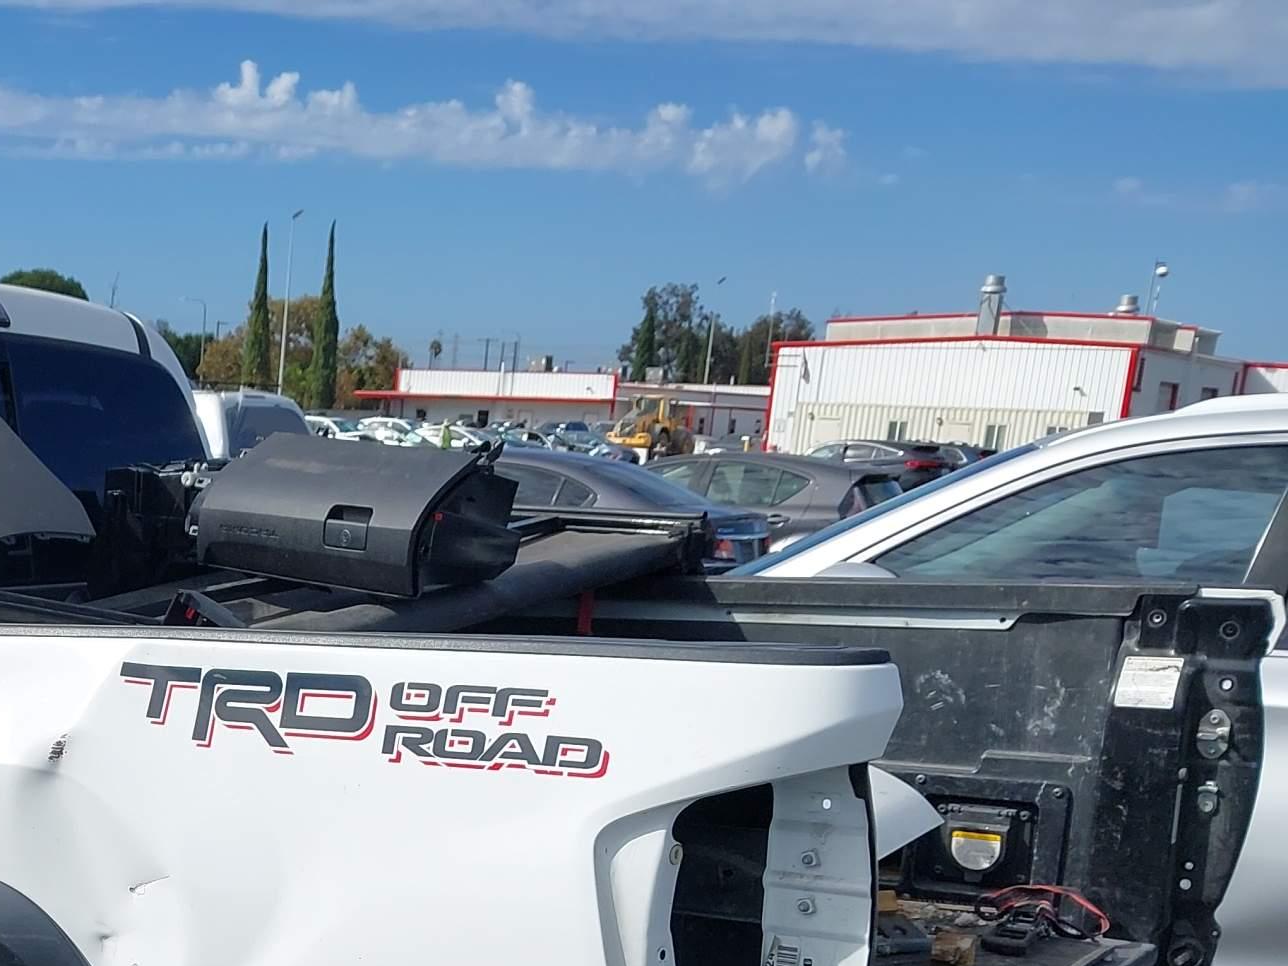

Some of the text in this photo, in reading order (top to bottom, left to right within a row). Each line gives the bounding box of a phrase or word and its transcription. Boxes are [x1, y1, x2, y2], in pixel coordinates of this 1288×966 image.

[120, 661, 378, 755] TRD
[388, 681, 556, 725] OFF
[381, 724, 610, 778] ROAD
